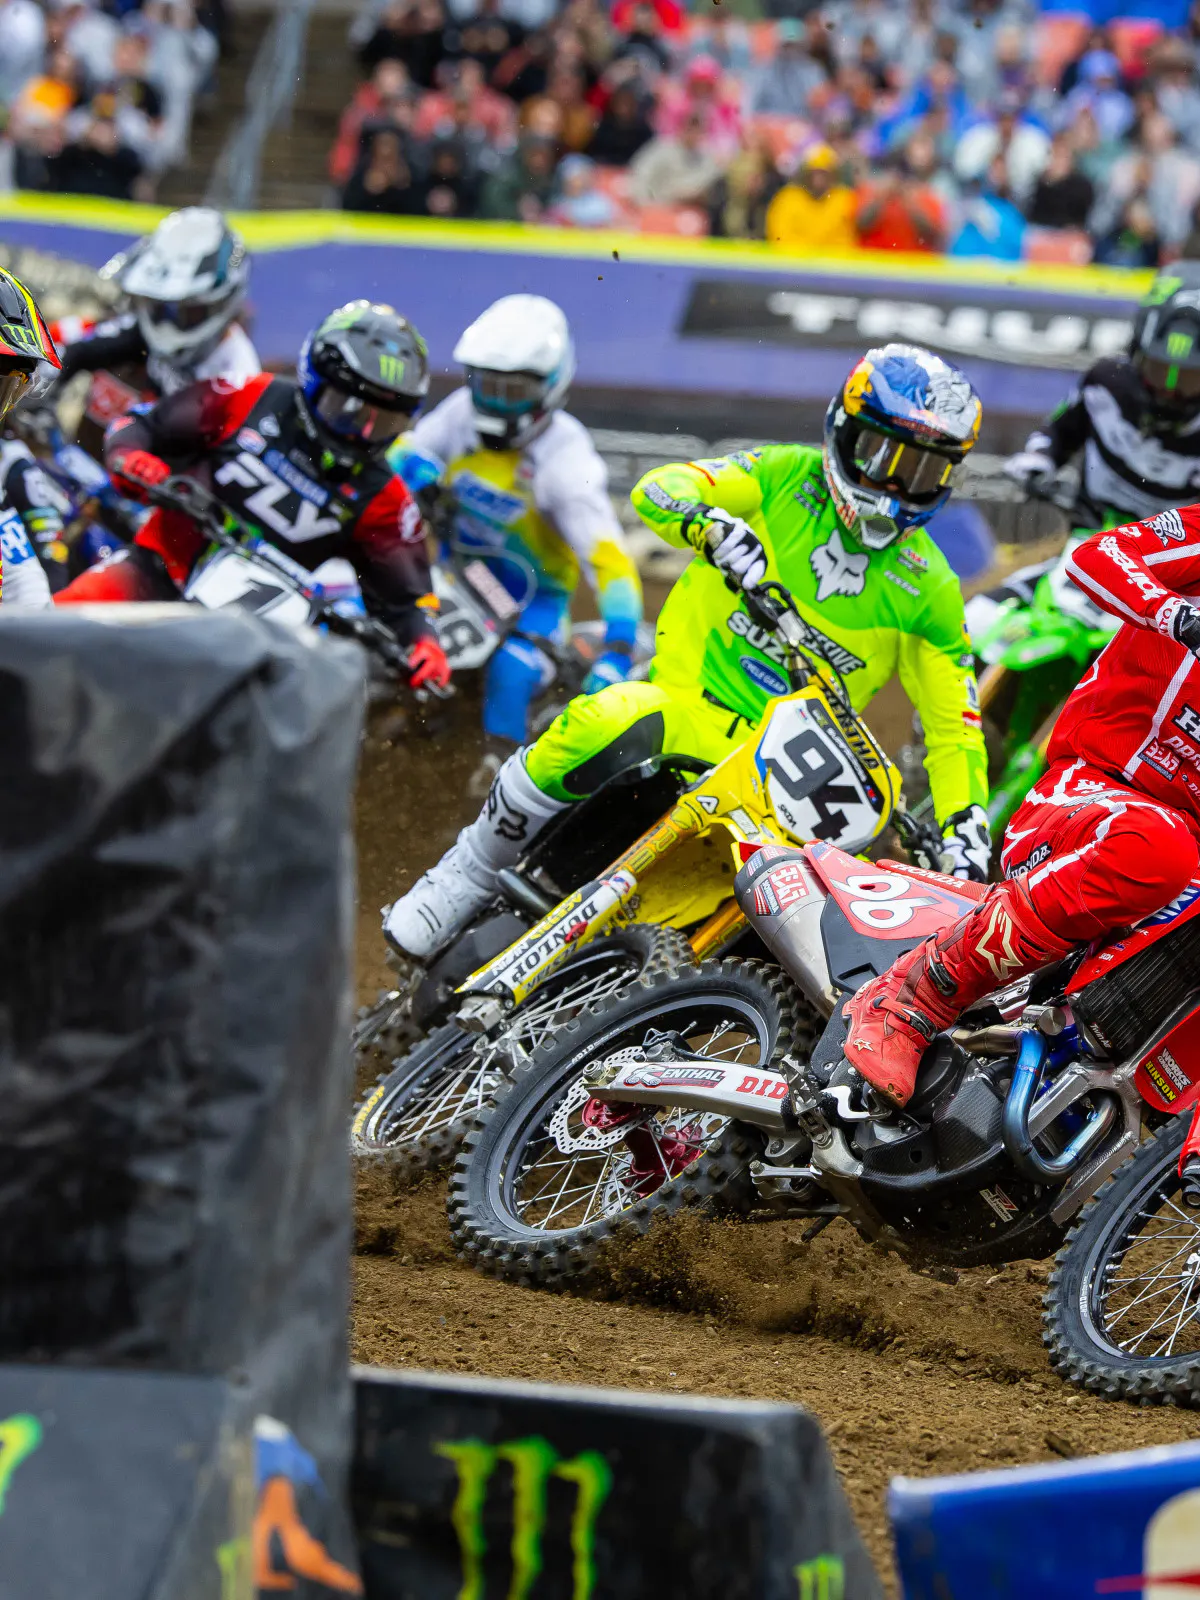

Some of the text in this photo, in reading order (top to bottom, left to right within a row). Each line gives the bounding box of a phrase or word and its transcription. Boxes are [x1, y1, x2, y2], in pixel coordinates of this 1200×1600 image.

[214, 450, 342, 543] FLY
[763, 728, 863, 841] 94
[892, 862, 965, 889] HONDA
[829, 874, 942, 930] 96
[511, 901, 599, 985] DUNLOP
[1089, 1022, 1105, 1043] Twin
[1144, 1059, 1177, 1102] HINSON
[1156, 1054, 1184, 1094] CONNECTION
[1162, 1046, 1193, 1087] WORKS
